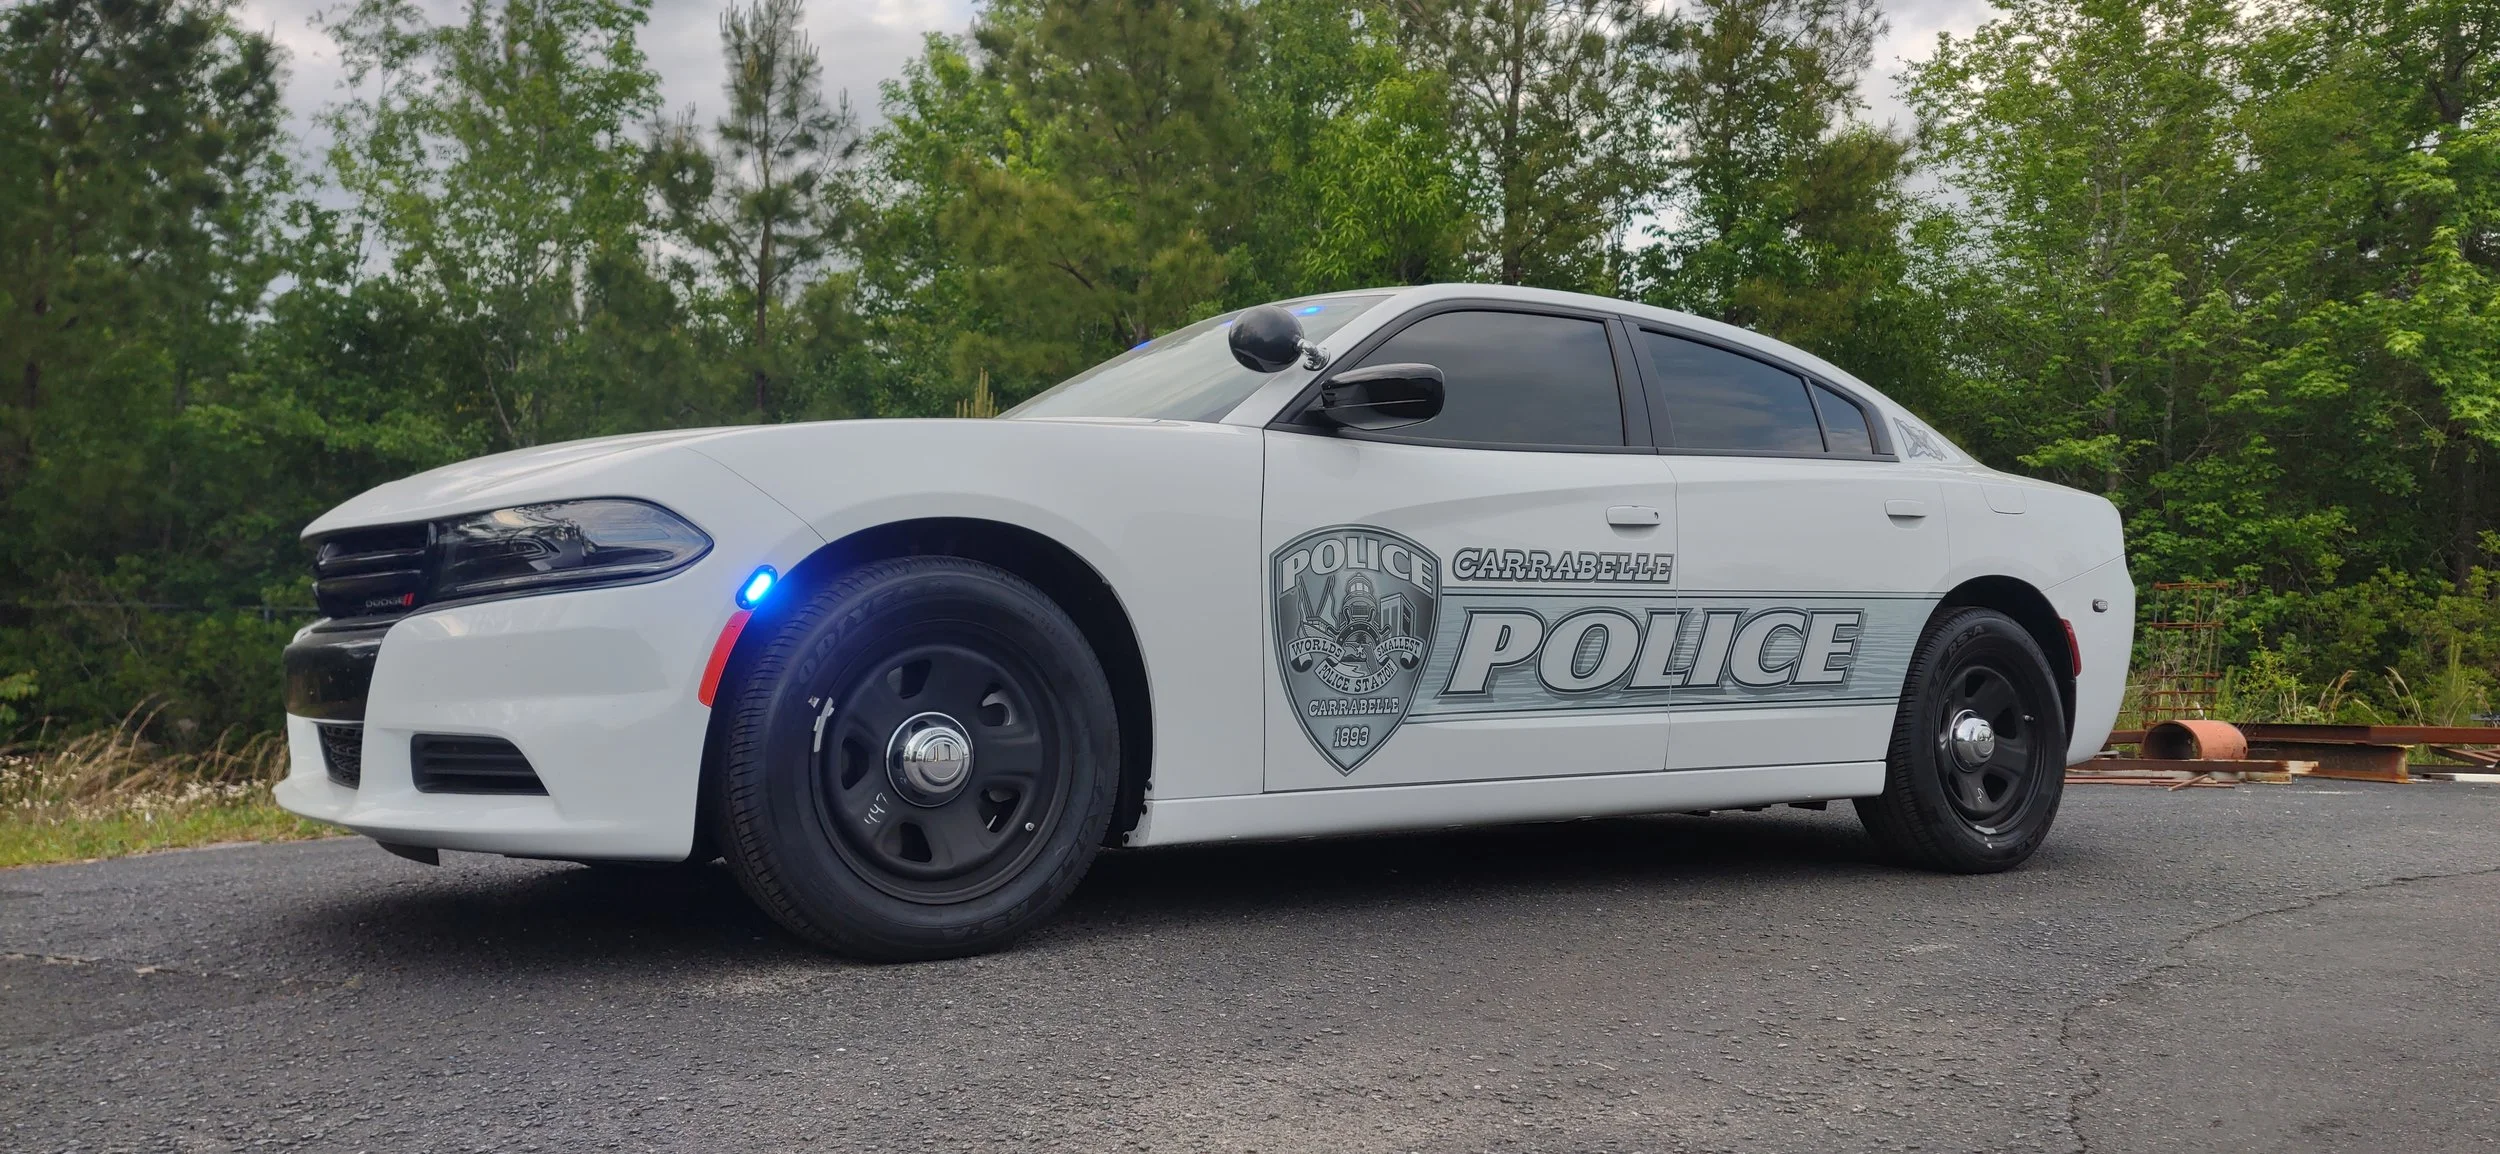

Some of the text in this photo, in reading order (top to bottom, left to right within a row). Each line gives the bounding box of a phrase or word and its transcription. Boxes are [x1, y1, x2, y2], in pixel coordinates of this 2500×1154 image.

[1280, 536, 1433, 594] POLICE
[1453, 547, 1674, 583] CARRABELLE
[1291, 638, 1420, 660] WORLDS SMALLEST
[1438, 606, 1865, 699] POLICE
[1319, 663, 1395, 692] POLICE STATION
[1308, 698, 1399, 717] CARRABELLE
[1333, 726, 1370, 748] 1893
